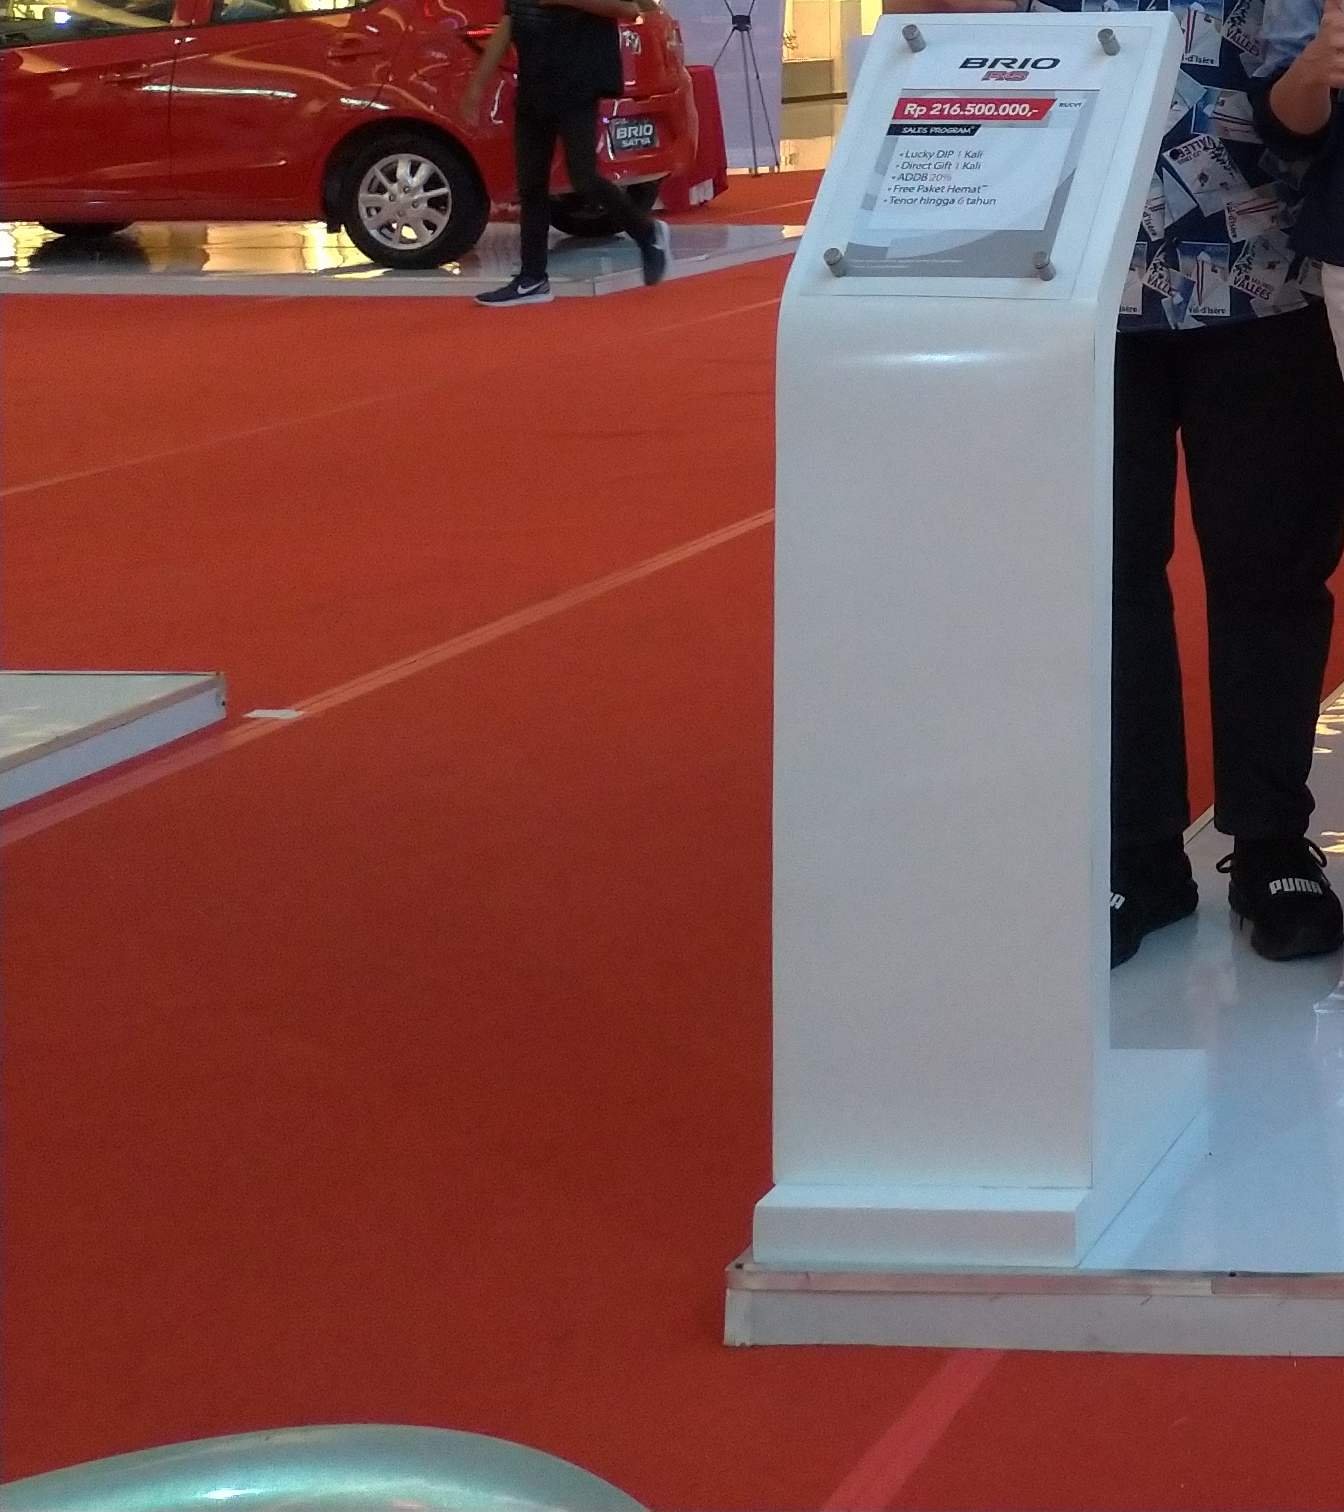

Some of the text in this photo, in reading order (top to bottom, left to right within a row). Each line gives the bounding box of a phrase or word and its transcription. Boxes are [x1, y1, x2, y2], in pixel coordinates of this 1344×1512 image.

[959, 57, 1061, 69] BRIO
[904, 103, 927, 118] Rp
[930, 103, 1039, 117] 216.500.000,-
[616, 124, 653, 139] BRIO
[621, 137, 651, 148] SATYA
[905, 150, 935, 160] Lucky
[936, 150, 954, 158] DIP
[964, 150, 984, 158] Kali
[901, 162, 932, 170] Direct
[934, 161, 953, 170] Gift
[962, 162, 981, 170] Kali
[893, 185, 945, 193] Free Paket
[889, 197, 997, 207] Tenor hingga 6 tahun
[1268, 877, 1323, 895] PUMA
